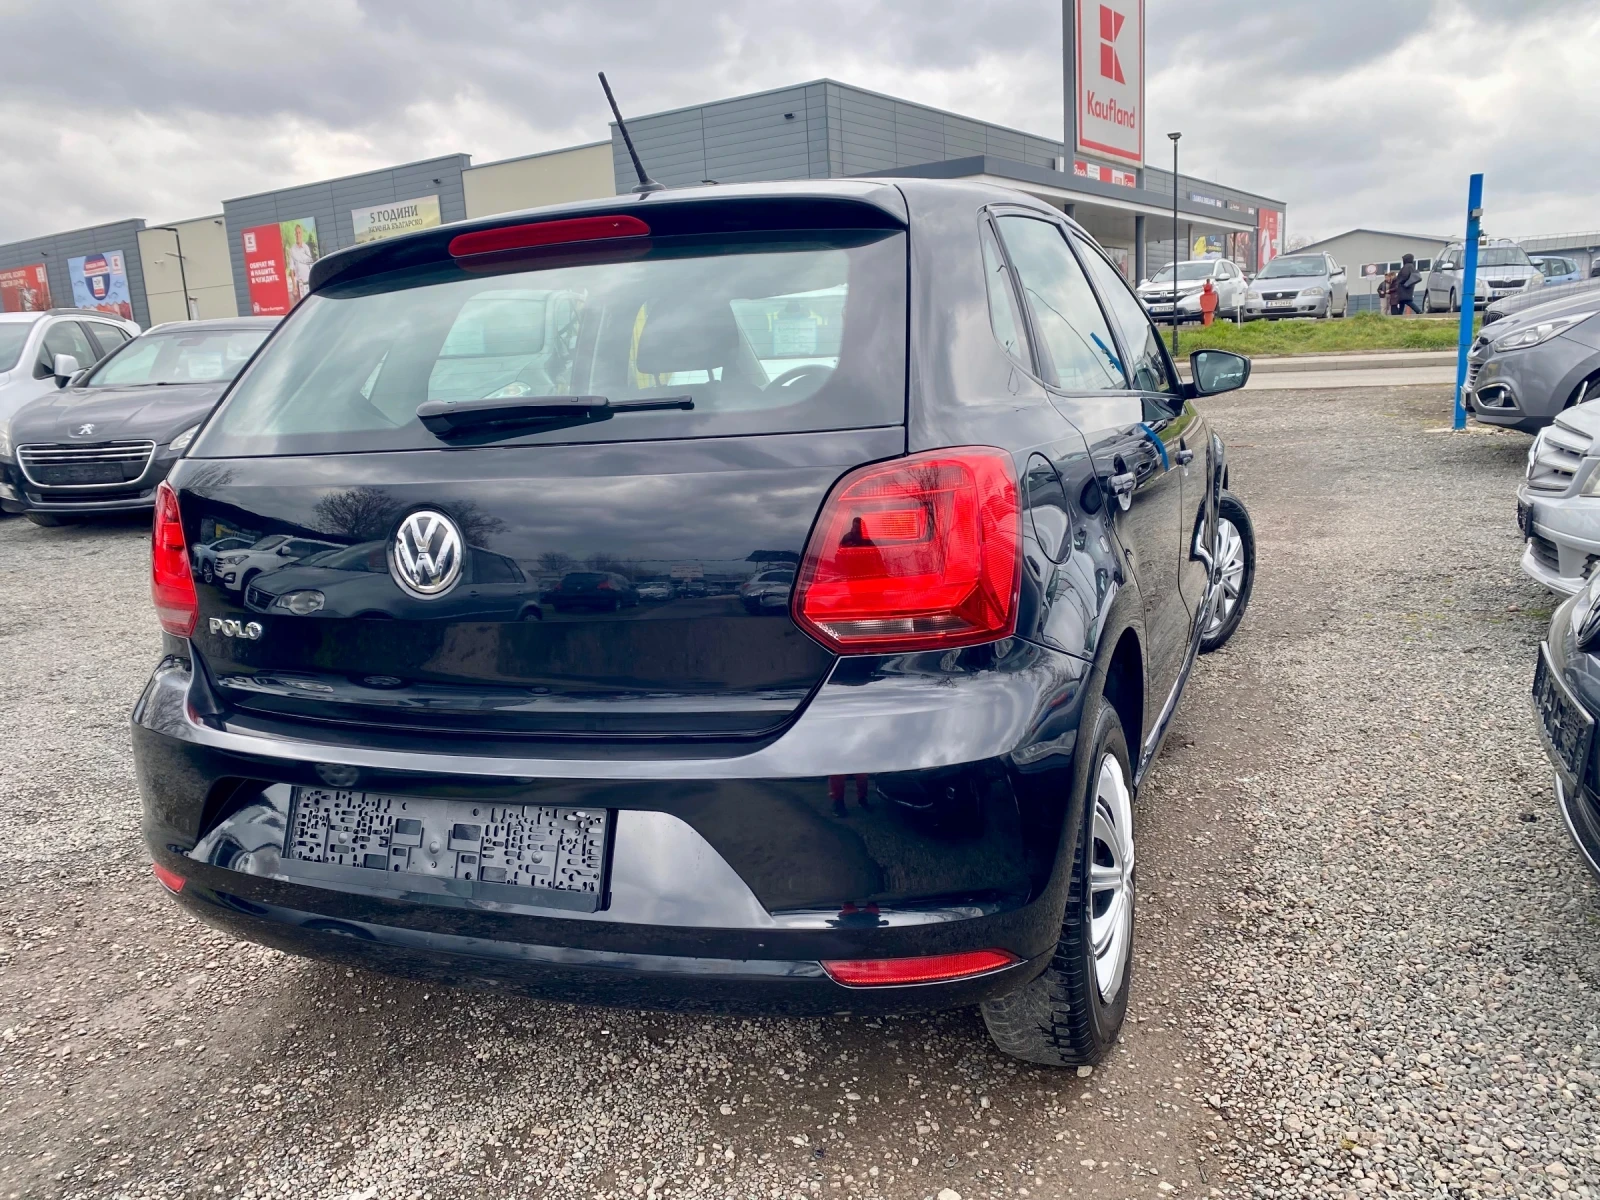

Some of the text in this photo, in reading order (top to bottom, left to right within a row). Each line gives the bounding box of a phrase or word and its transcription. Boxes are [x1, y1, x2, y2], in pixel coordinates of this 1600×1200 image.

[1087, 89, 1136, 129] Kaufland
[370, 204, 419, 224] 5 ГОДИНИ
[391, 218, 423, 230] БЪЛГАРСКО
[249, 260, 267, 269] ОБИЧАТ
[208, 617, 263, 640] POLO
